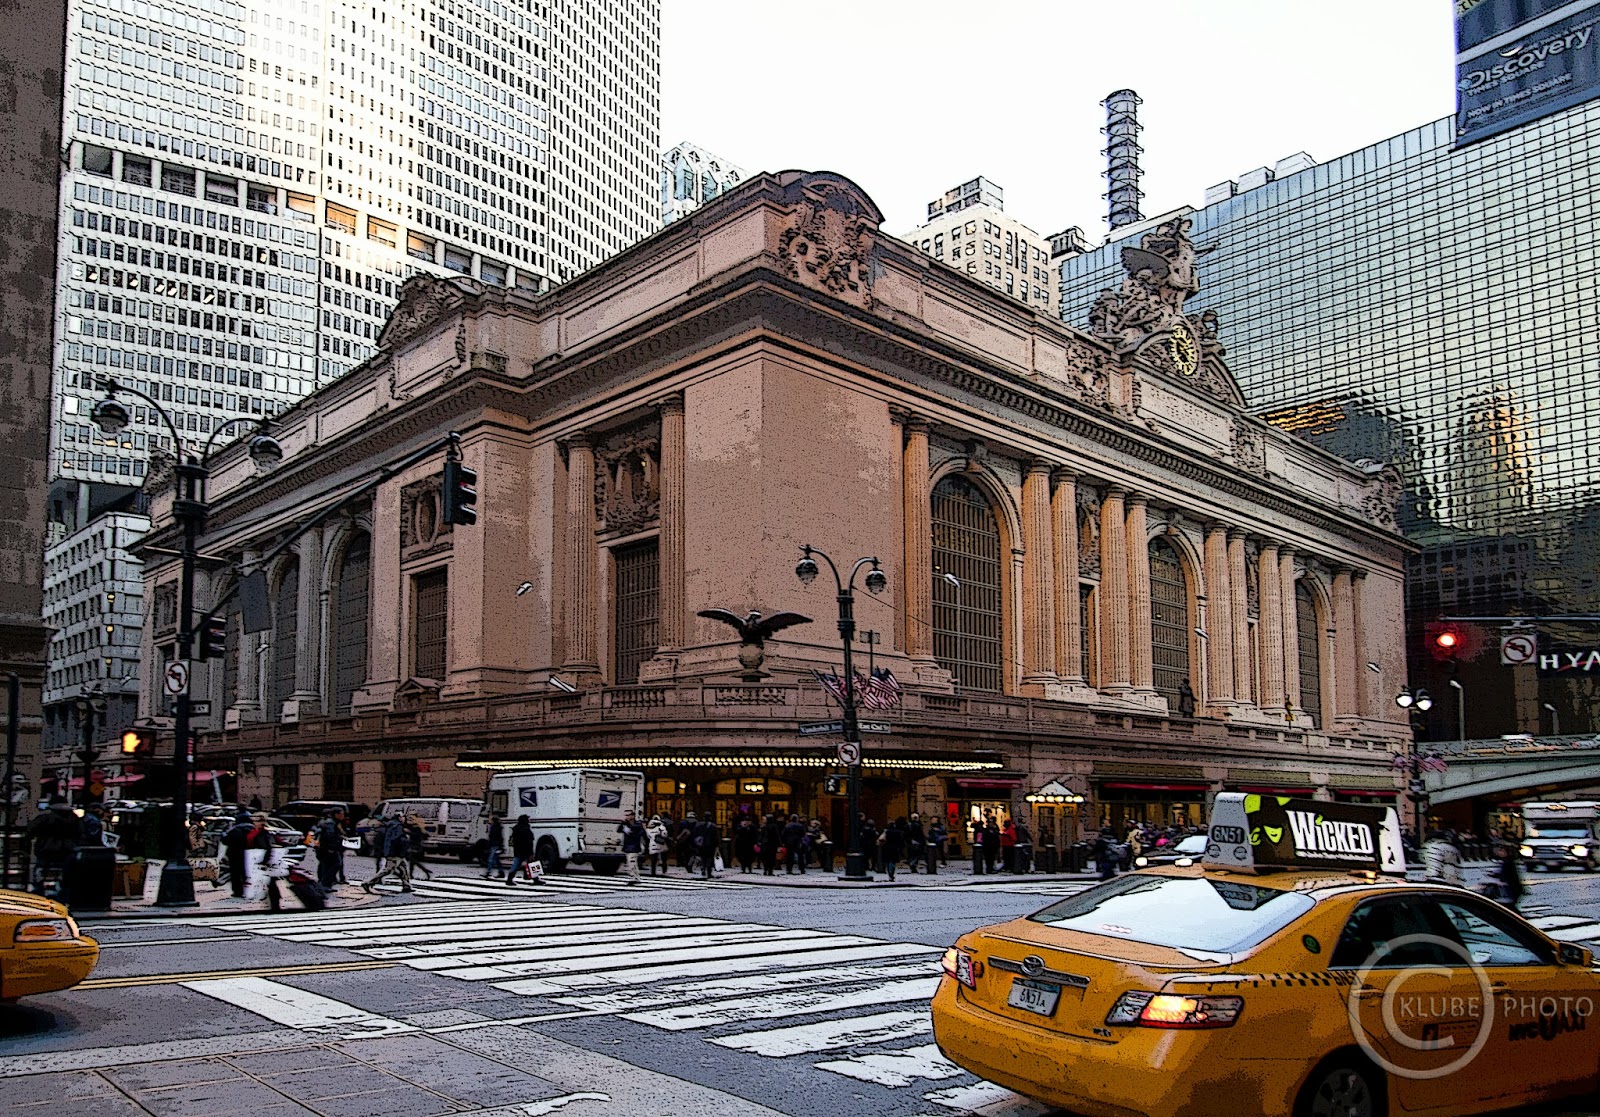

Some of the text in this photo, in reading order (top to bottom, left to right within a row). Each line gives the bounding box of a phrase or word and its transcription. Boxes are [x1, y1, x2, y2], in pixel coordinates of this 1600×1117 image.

[1466, 26, 1592, 89] Discovery
[1467, 103, 1492, 118] NOW
[1213, 826, 1244, 844] 6N51
